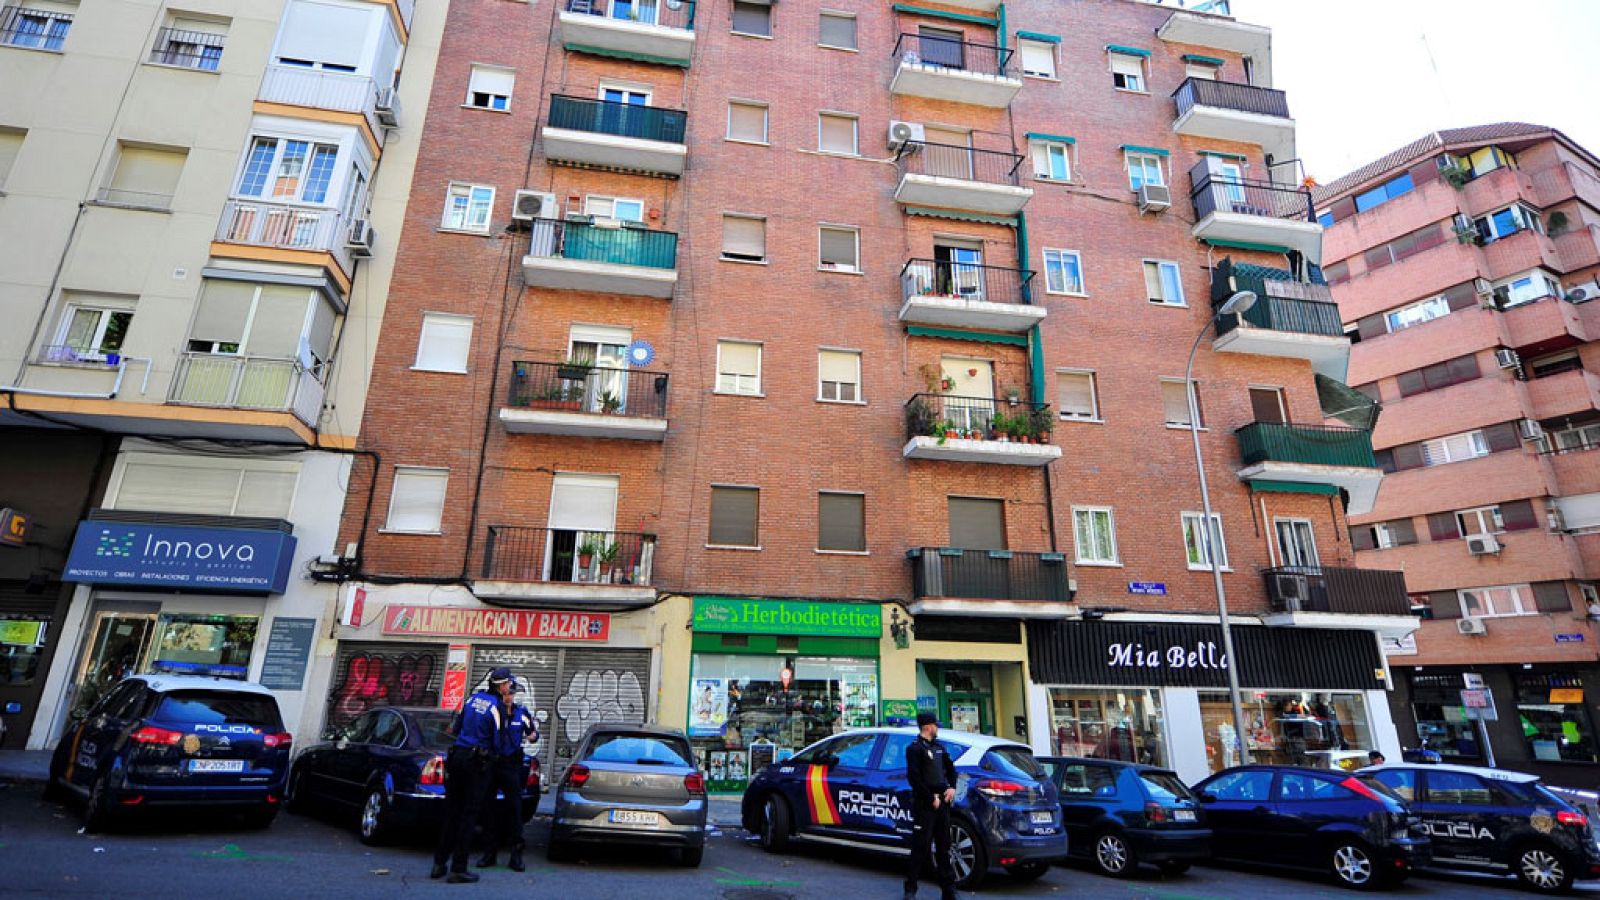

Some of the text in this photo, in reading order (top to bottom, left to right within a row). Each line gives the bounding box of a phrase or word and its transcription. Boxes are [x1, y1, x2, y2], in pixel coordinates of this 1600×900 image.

[144, 533, 254, 562] Innova
[69, 568, 108, 578] PROYECTOS
[114, 571, 135, 579] OBRAS
[141, 572, 190, 582] INSTALACIONES
[196, 574, 229, 583] EFICIENCIA
[525, 612, 537, 637] Y
[539, 612, 589, 638] BAZAR
[742, 602, 880, 627] Herbodietética
[1108, 642, 1161, 668] Mia
[838, 802, 914, 821] NACIONAL
